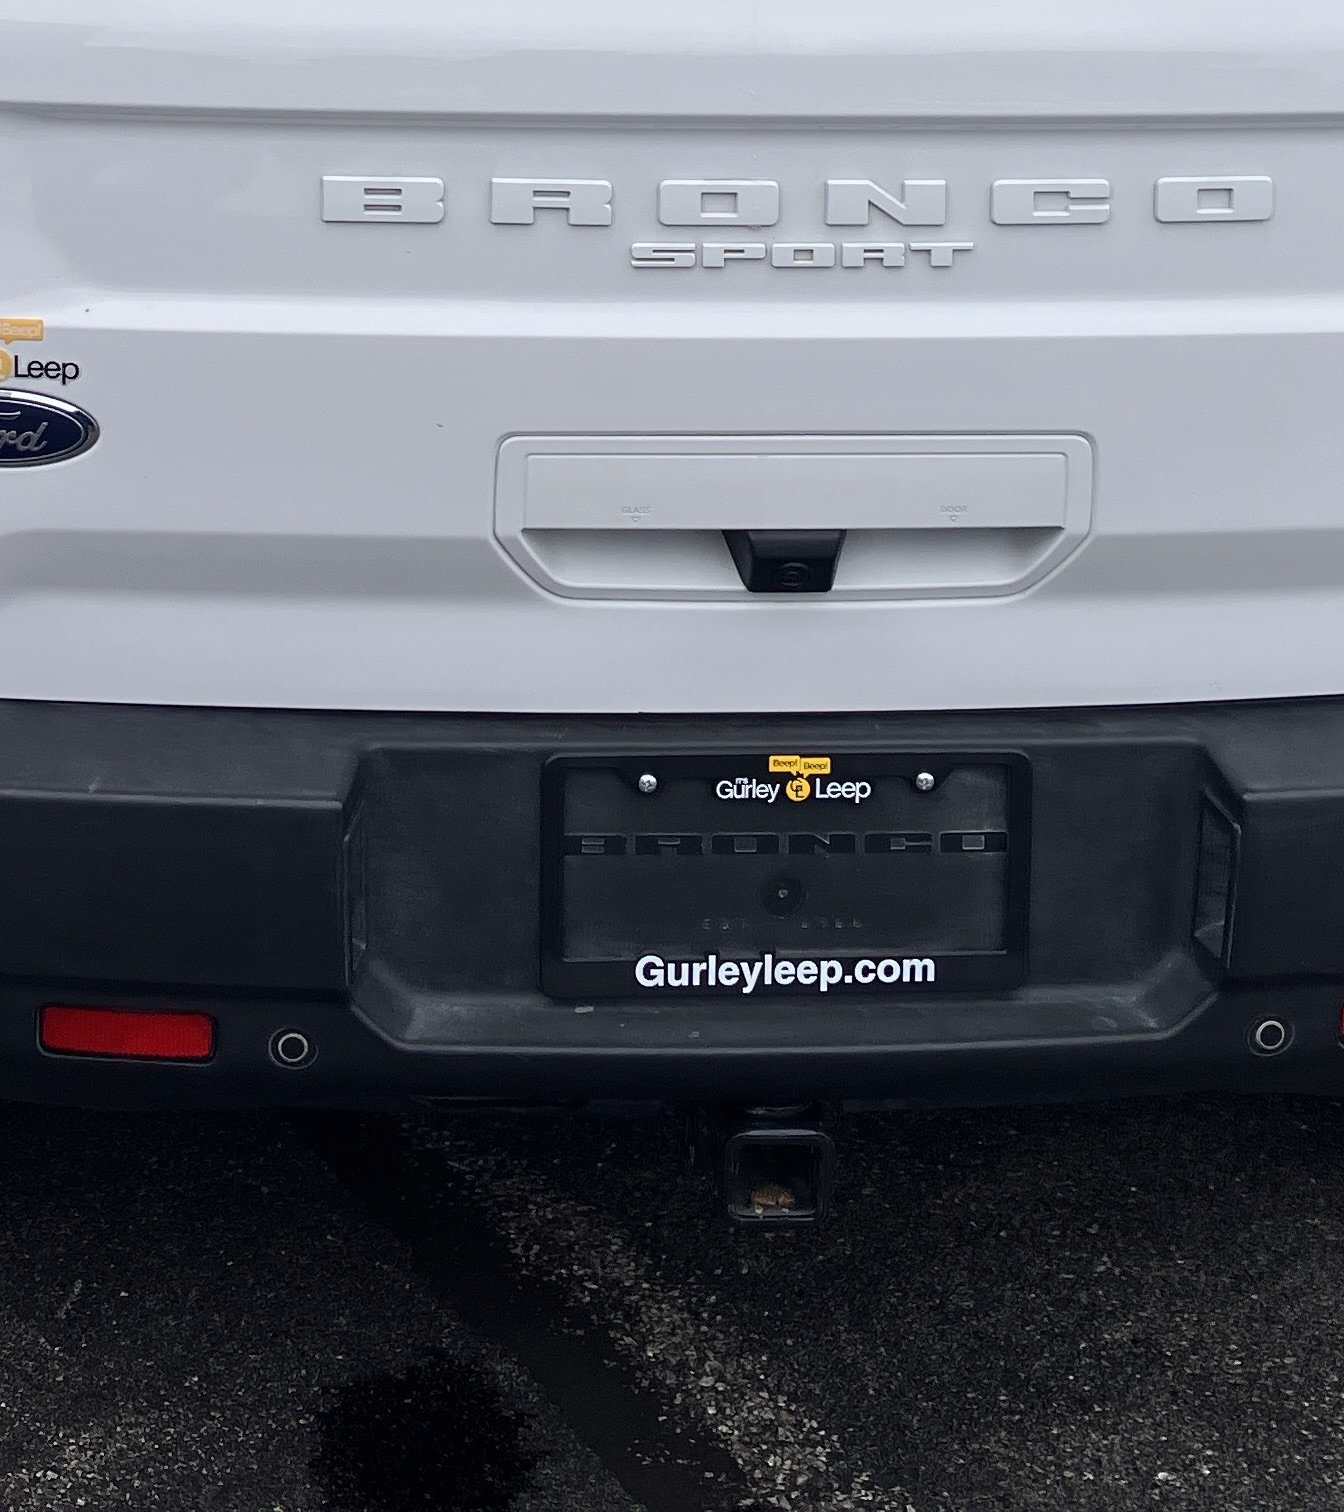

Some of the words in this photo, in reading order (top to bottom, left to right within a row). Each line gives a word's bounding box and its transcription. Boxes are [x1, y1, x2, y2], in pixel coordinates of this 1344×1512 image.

[320, 175, 1275, 227] BRONCO
[629, 240, 975, 271] SPORT
[14, 355, 80, 385] Leep
[716, 778, 781, 804] Gurley
[815, 778, 872, 804] Leep
[635, 954, 936, 993] Gurleyleep.com
